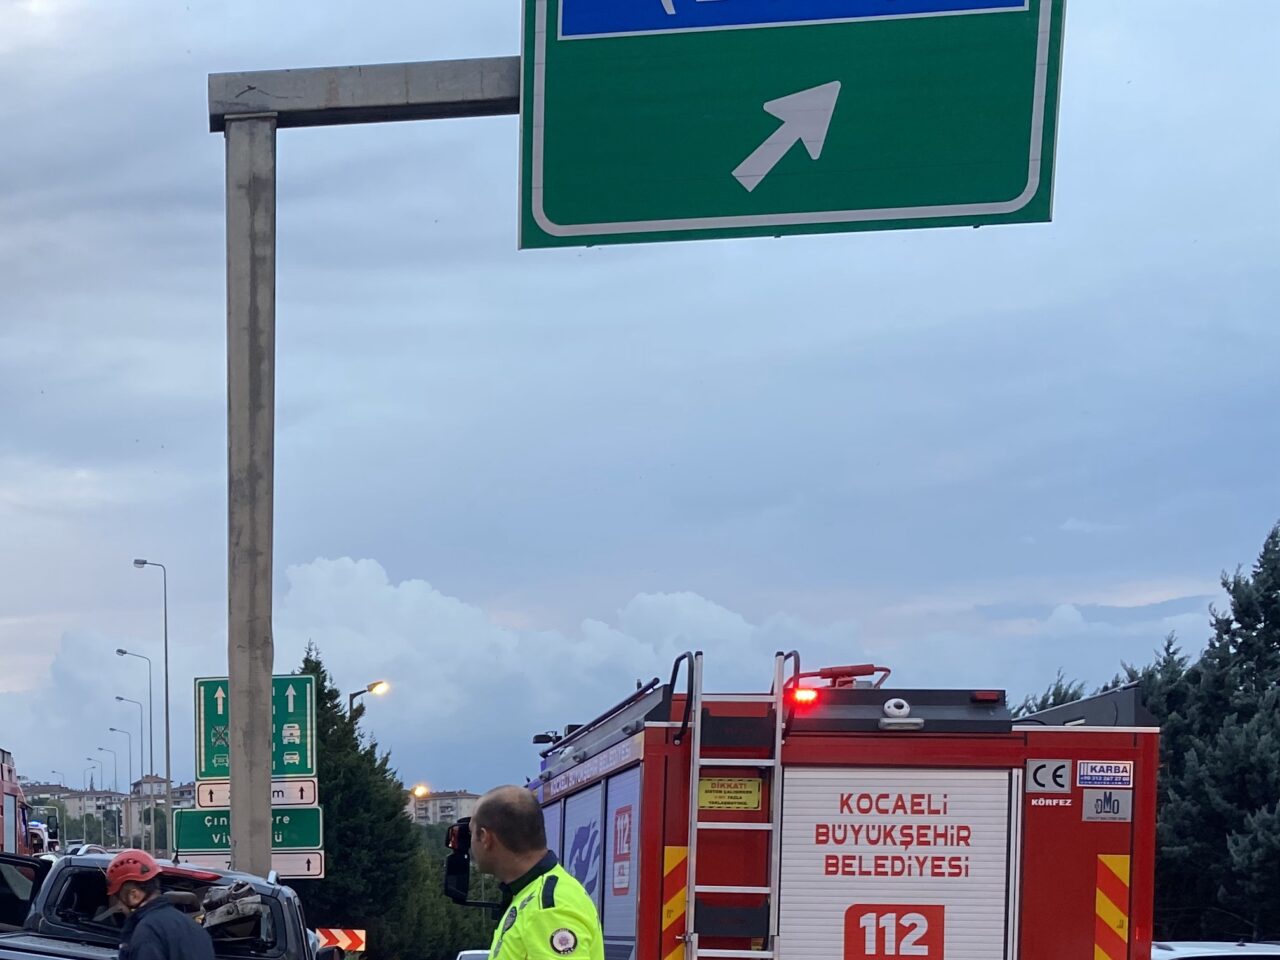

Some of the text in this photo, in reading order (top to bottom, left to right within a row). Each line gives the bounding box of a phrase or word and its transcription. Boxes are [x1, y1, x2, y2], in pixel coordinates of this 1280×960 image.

[1090, 765, 1128, 774] KARBA
[1031, 798, 1072, 806] KÖRFEZ
[815, 824, 972, 851] BÜYÜKŞEHİR
[824, 855, 969, 878] BELEDİYESİ
[859, 912, 929, 956] 112
